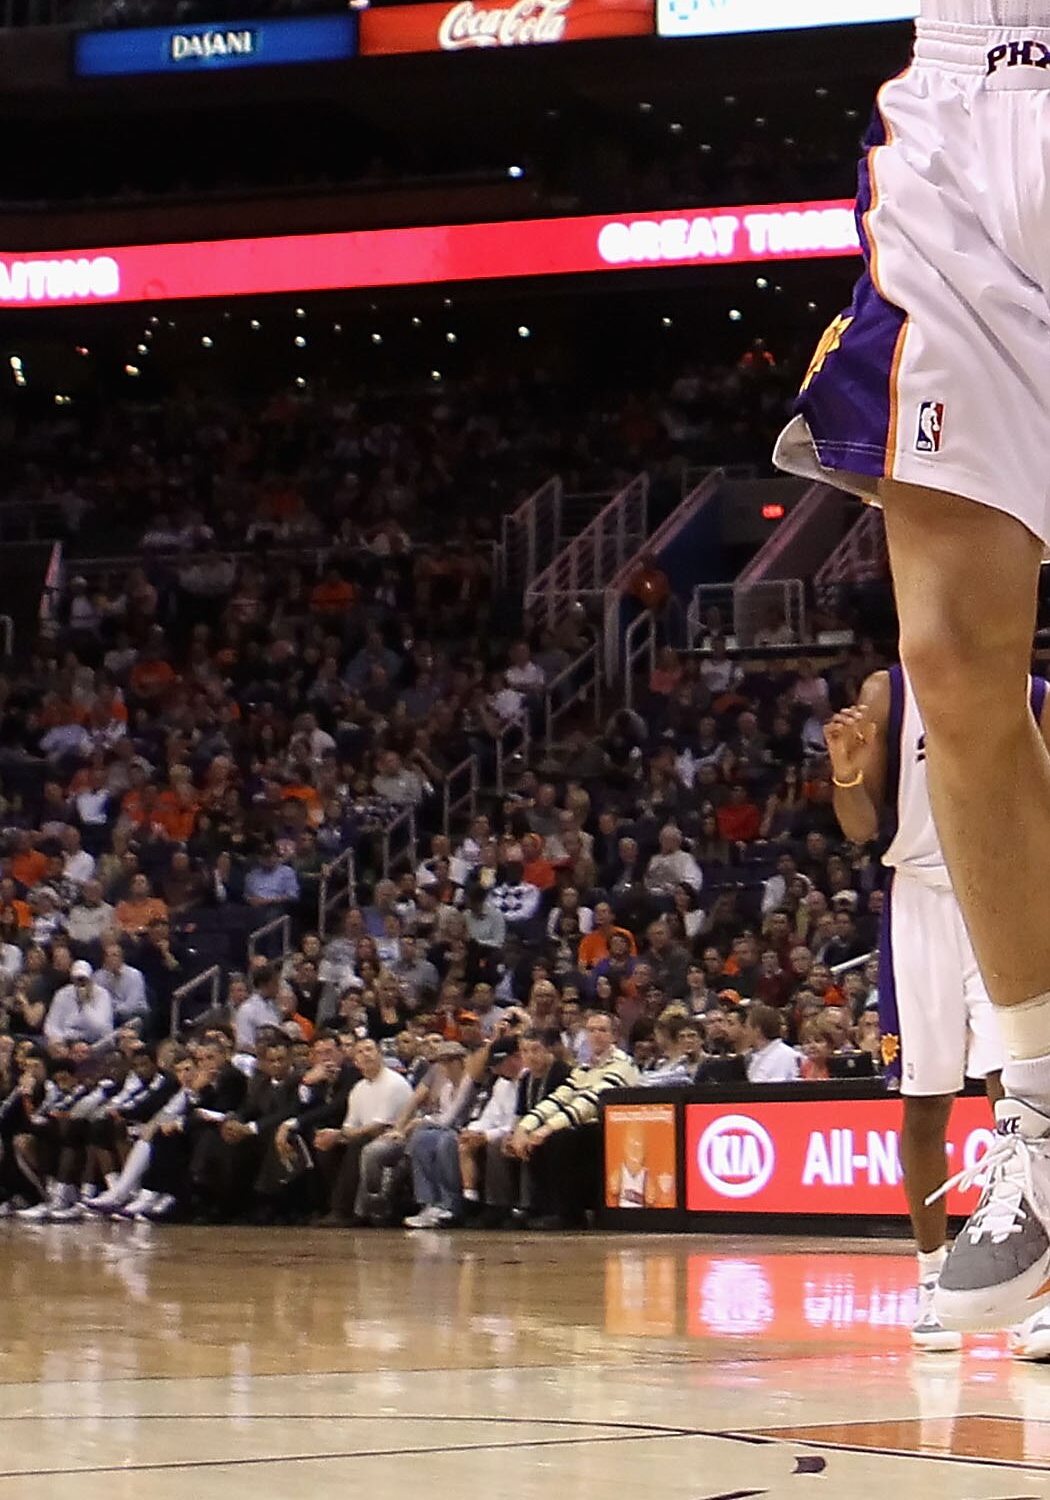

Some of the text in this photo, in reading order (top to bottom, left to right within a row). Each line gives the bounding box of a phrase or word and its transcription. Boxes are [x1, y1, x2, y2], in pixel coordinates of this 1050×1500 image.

[171, 30, 252, 60] DASANI
[598, 216, 739, 264] GREAT
[710, 1133, 762, 1177] KIA
